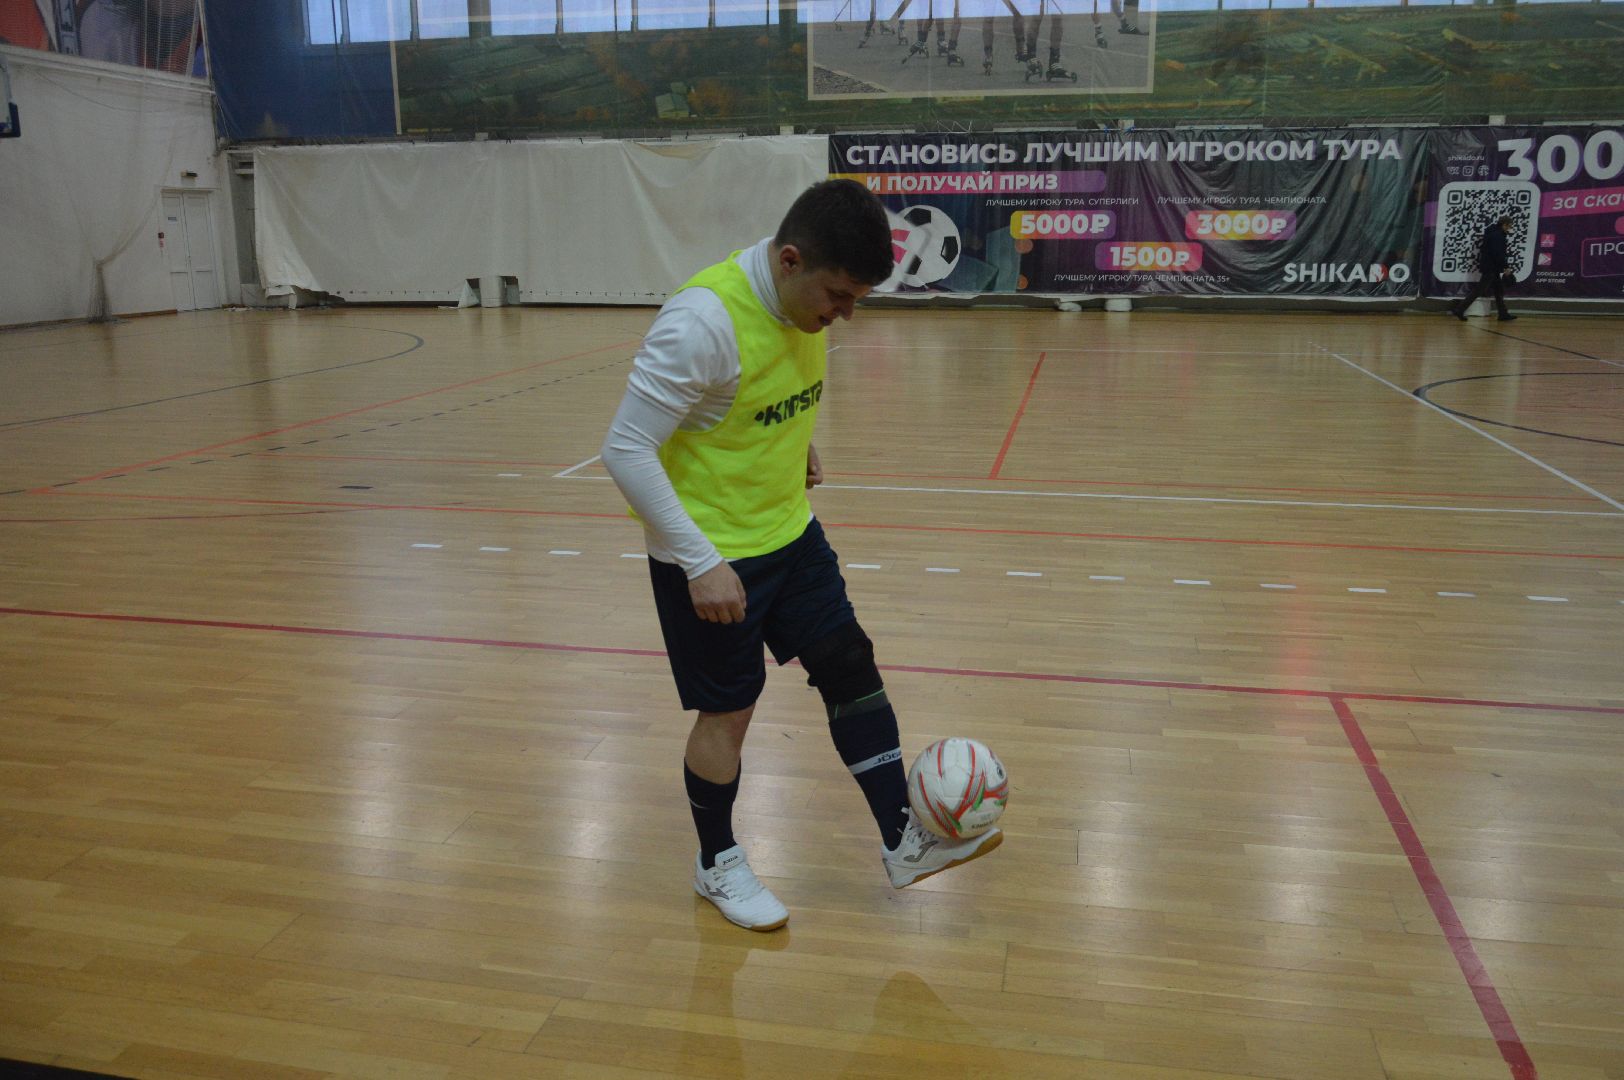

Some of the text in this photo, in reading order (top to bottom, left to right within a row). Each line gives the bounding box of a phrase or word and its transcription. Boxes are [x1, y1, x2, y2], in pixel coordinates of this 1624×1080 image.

[846, 139, 1403, 165] СТАНОВИСЬ ЛУЧШИМ ИГРОКОМ ТУРА
[866, 171, 1058, 192] И ПОЛУЧАЙ ПРИЗ
[986, 199, 1028, 207] ЛУЧШЕМУ
[1088, 198, 1139, 206] СУПЕРЛИГИ
[1157, 196, 1327, 205] ЛУЧШЕМУ ИГРОКУ ТУРА ЧЕМПИОНАТА
[1583, 193, 1624, 208] ска
[1098, 274, 1131, 282] ИГРОКУ
[1156, 275, 1215, 283] ЧЕМПИОНАТА
